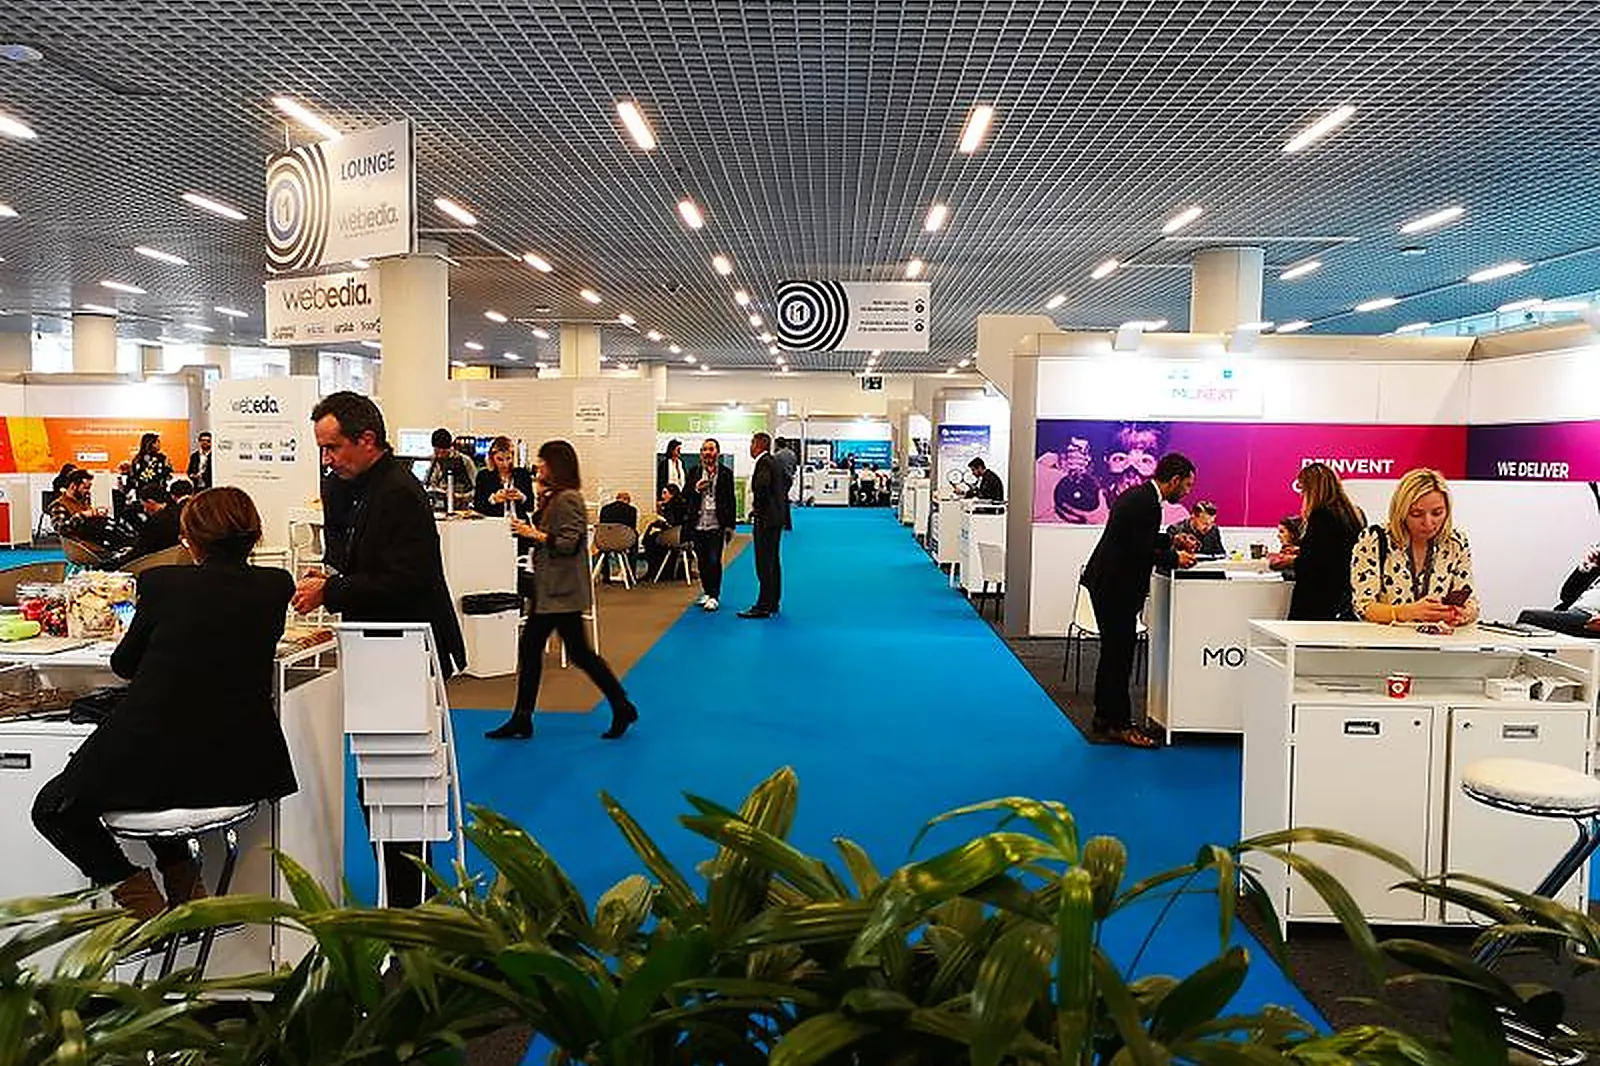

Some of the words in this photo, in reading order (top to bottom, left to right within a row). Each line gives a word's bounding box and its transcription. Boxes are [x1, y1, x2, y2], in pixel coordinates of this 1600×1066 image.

[341, 149, 395, 181] LOUNGE
[1301, 458, 1395, 474] RINVENT
[1497, 461, 1517, 477] WE
[1518, 462, 1569, 479] DELIVER
[1203, 647, 1248, 667] MO
